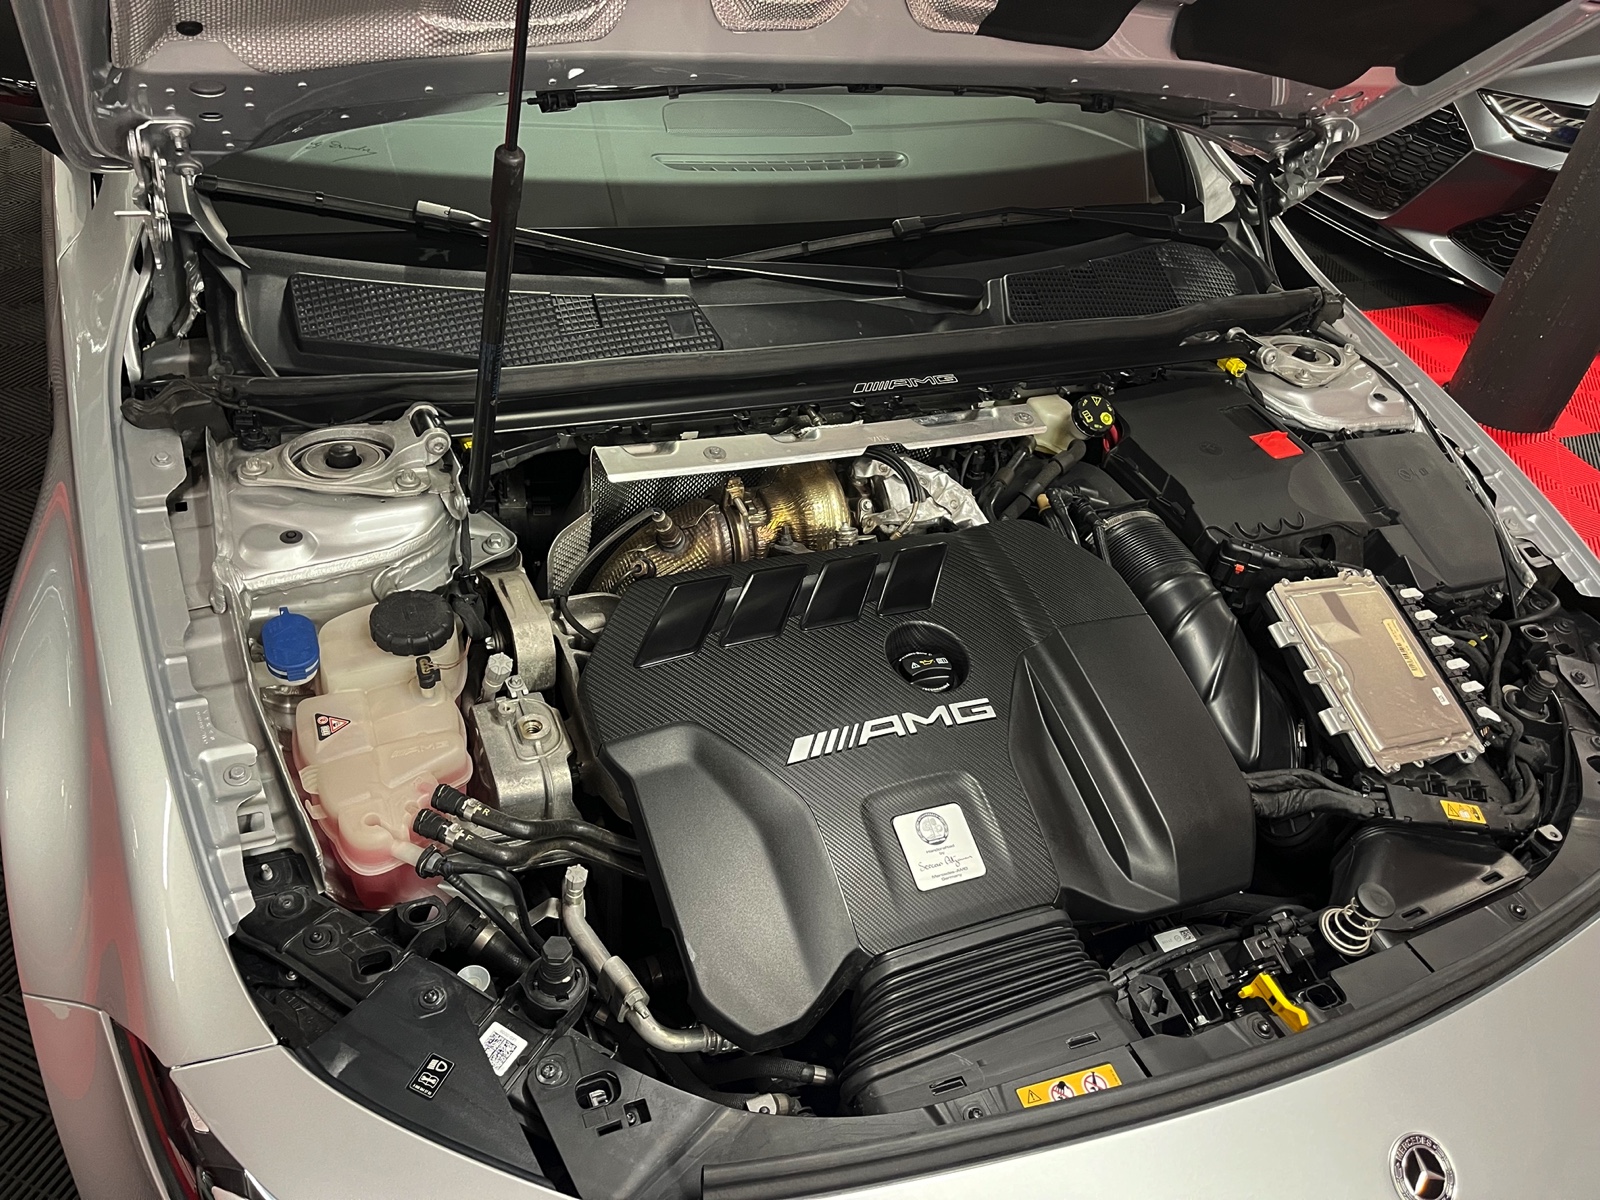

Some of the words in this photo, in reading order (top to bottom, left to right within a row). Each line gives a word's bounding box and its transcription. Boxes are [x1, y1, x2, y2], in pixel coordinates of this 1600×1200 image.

[482, 808, 490, 816] R
[941, 873, 962, 881] Germany
[1395, 1135, 1432, 1161] MERCEDES
